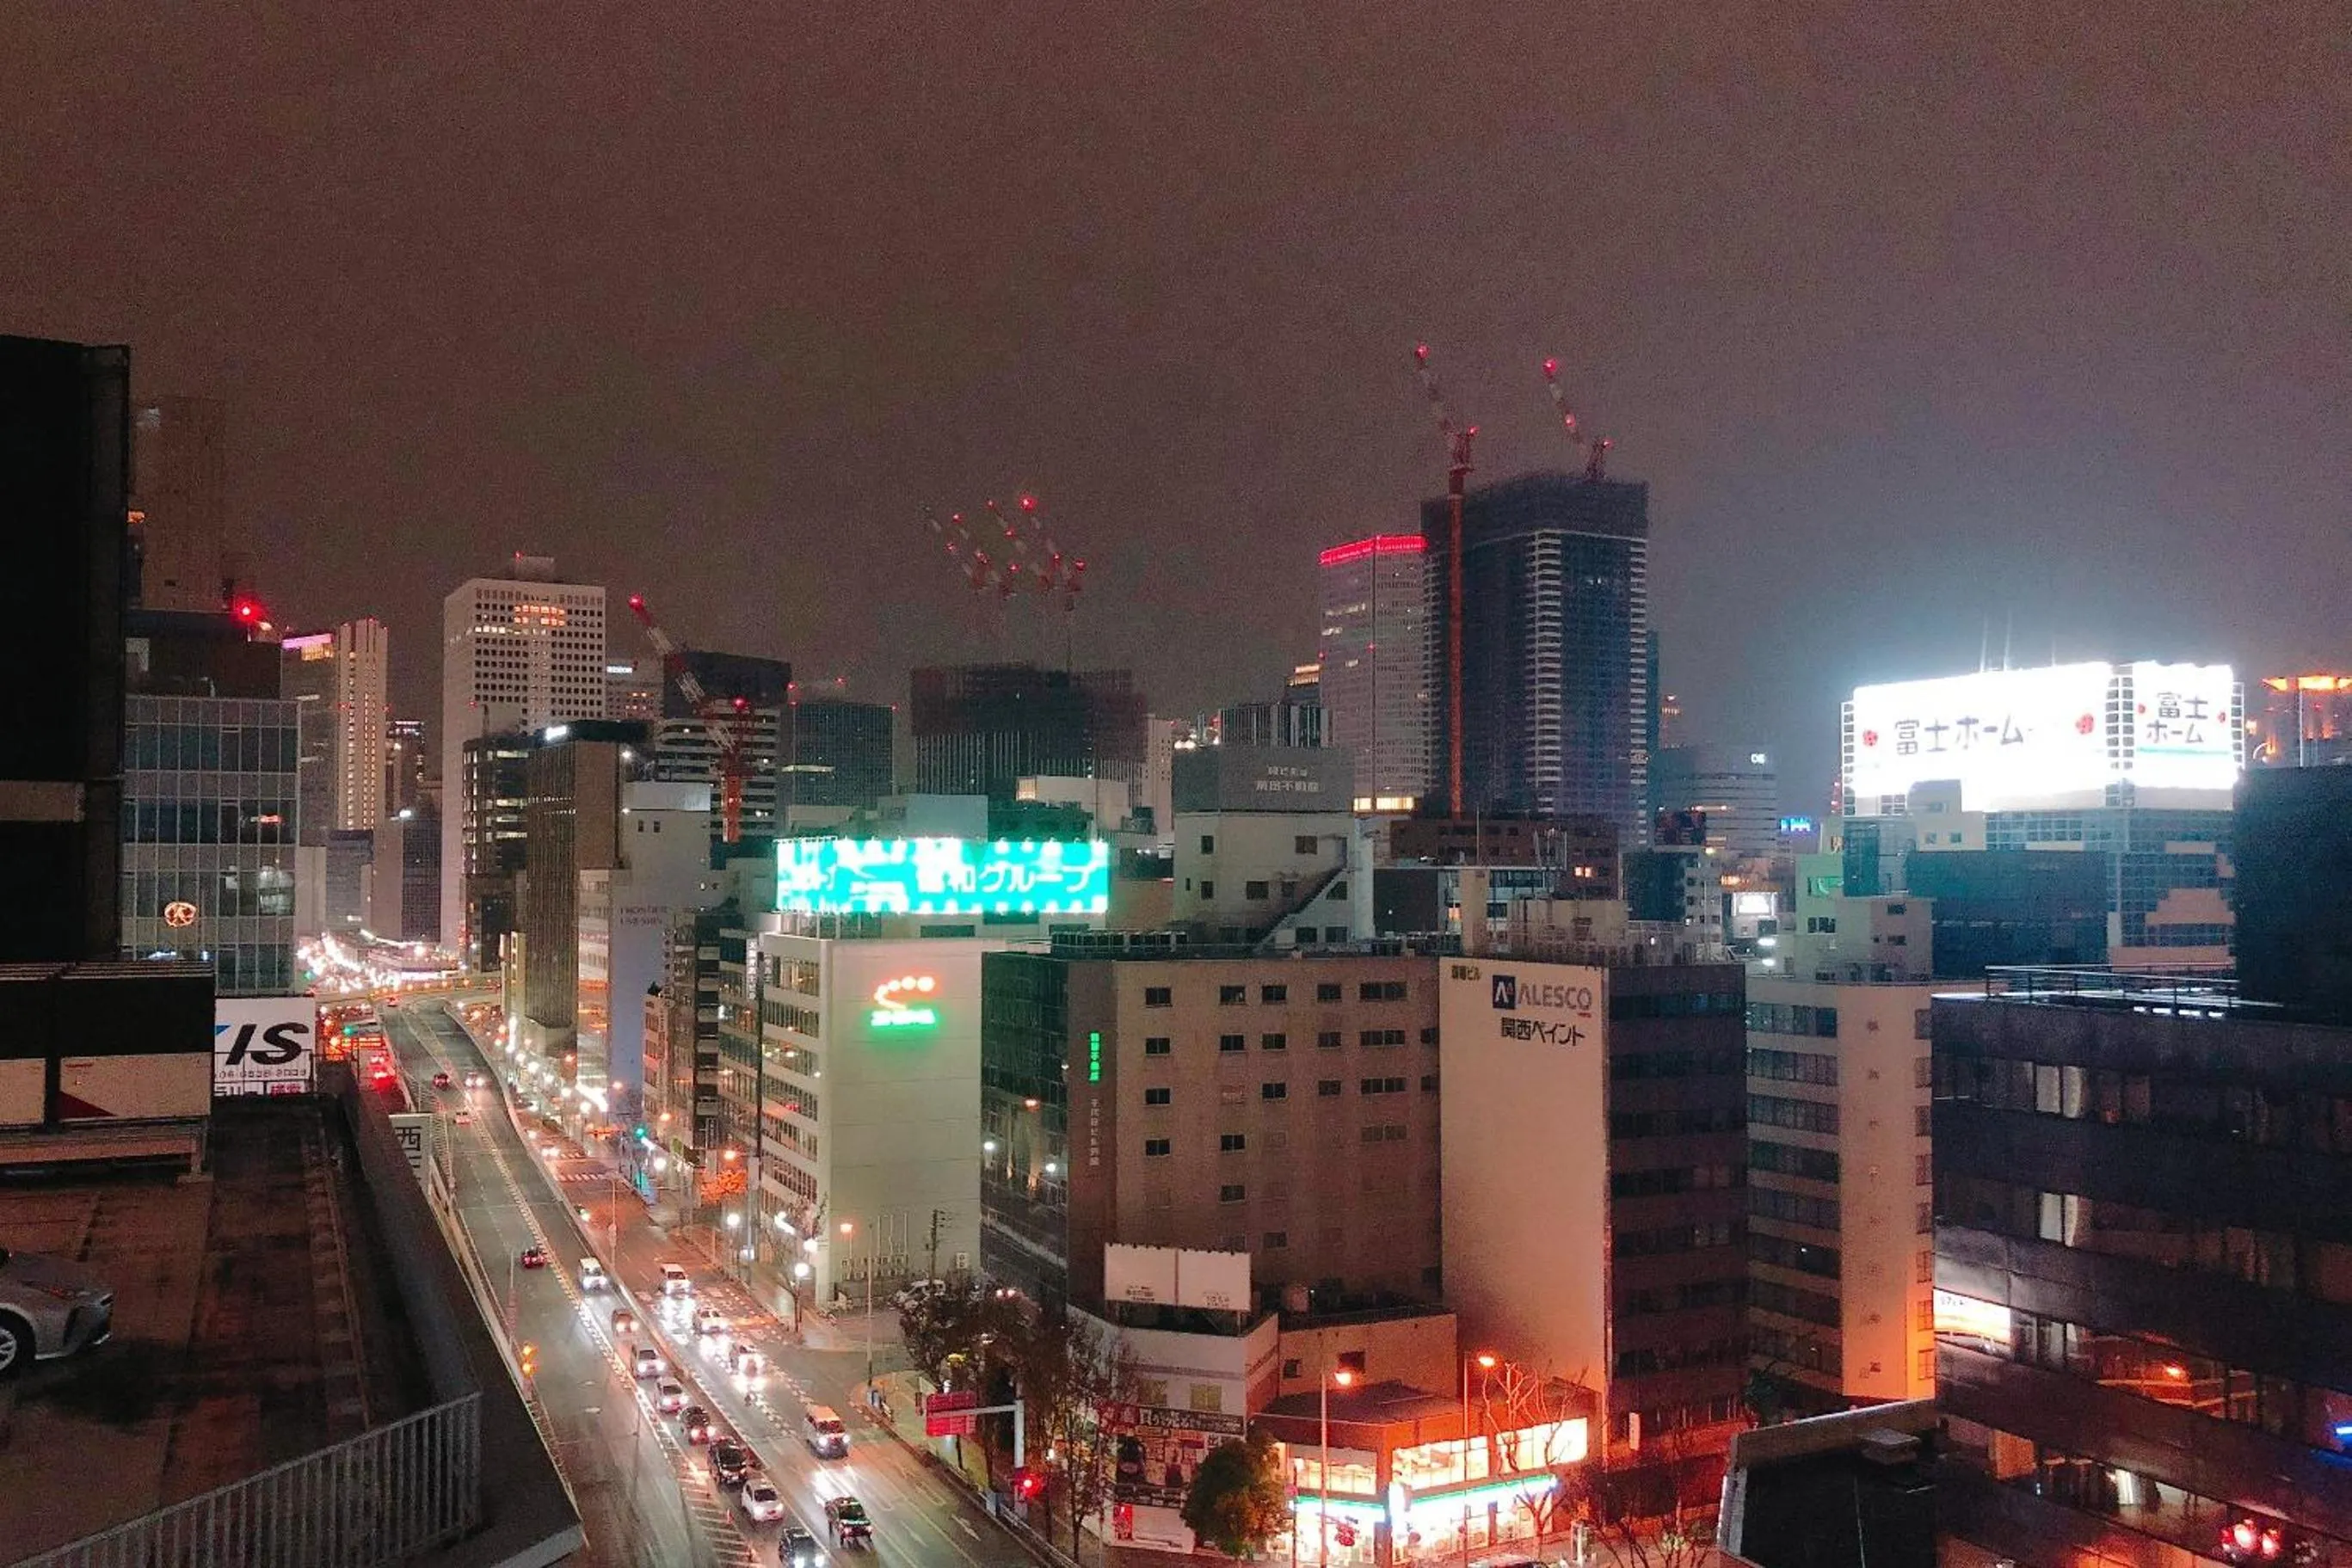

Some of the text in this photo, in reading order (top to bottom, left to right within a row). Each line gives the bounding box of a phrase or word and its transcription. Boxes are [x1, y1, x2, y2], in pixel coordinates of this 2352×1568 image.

[2156, 691, 2208, 719] 富士
[1894, 713, 2025, 756] 富士ホーム
[2146, 719, 2204, 744] ホーム
[1518, 982, 1592, 1011] ALESCO
[1500, 1017, 1585, 1046] 関西ペイント
